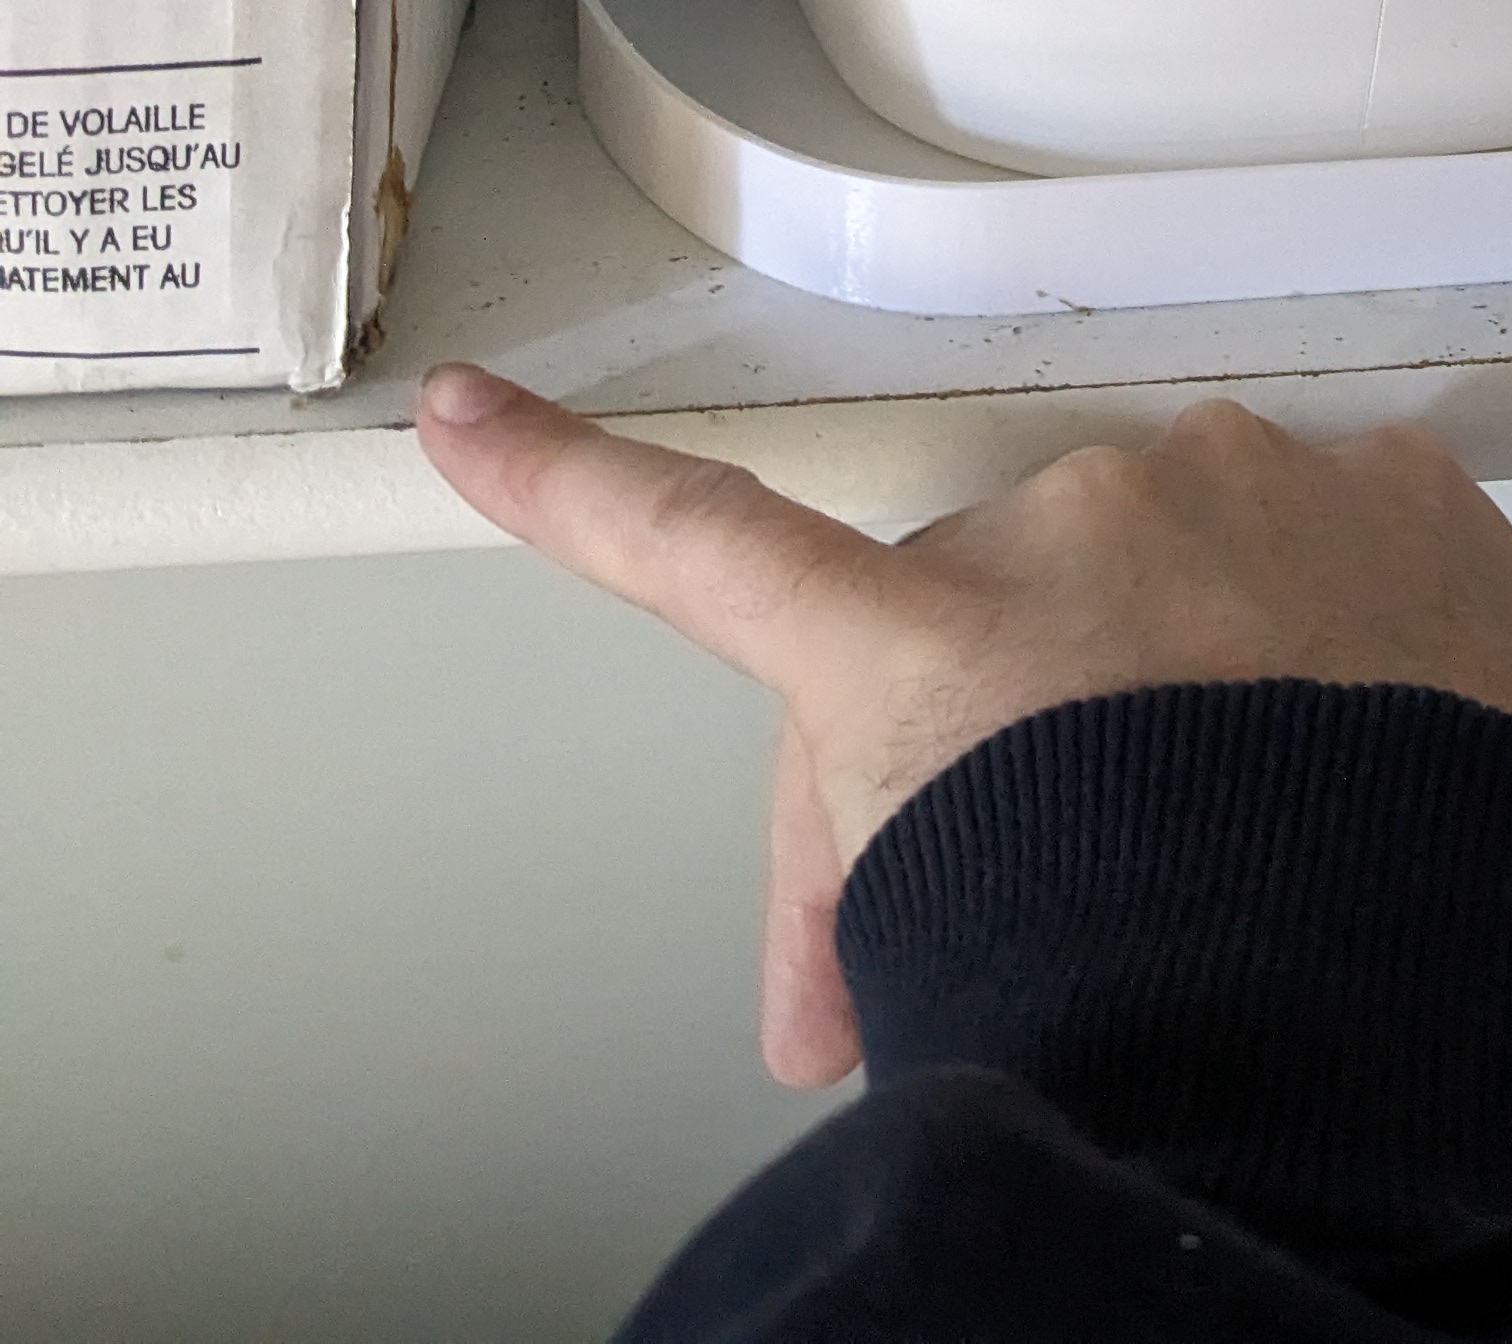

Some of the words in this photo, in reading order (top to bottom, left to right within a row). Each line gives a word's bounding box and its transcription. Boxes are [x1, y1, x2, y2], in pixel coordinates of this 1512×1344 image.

[6, 109, 50, 140] DE
[58, 102, 207, 138] VOLAILLE
[83, 141, 242, 178] JUSQU'AU
[141, 183, 199, 213] LES
[0, 227, 61, 257] U'IL
[69, 227, 91, 255] Y
[100, 225, 122, 254] A
[131, 223, 174, 253] EU
[159, 261, 202, 291] AU
